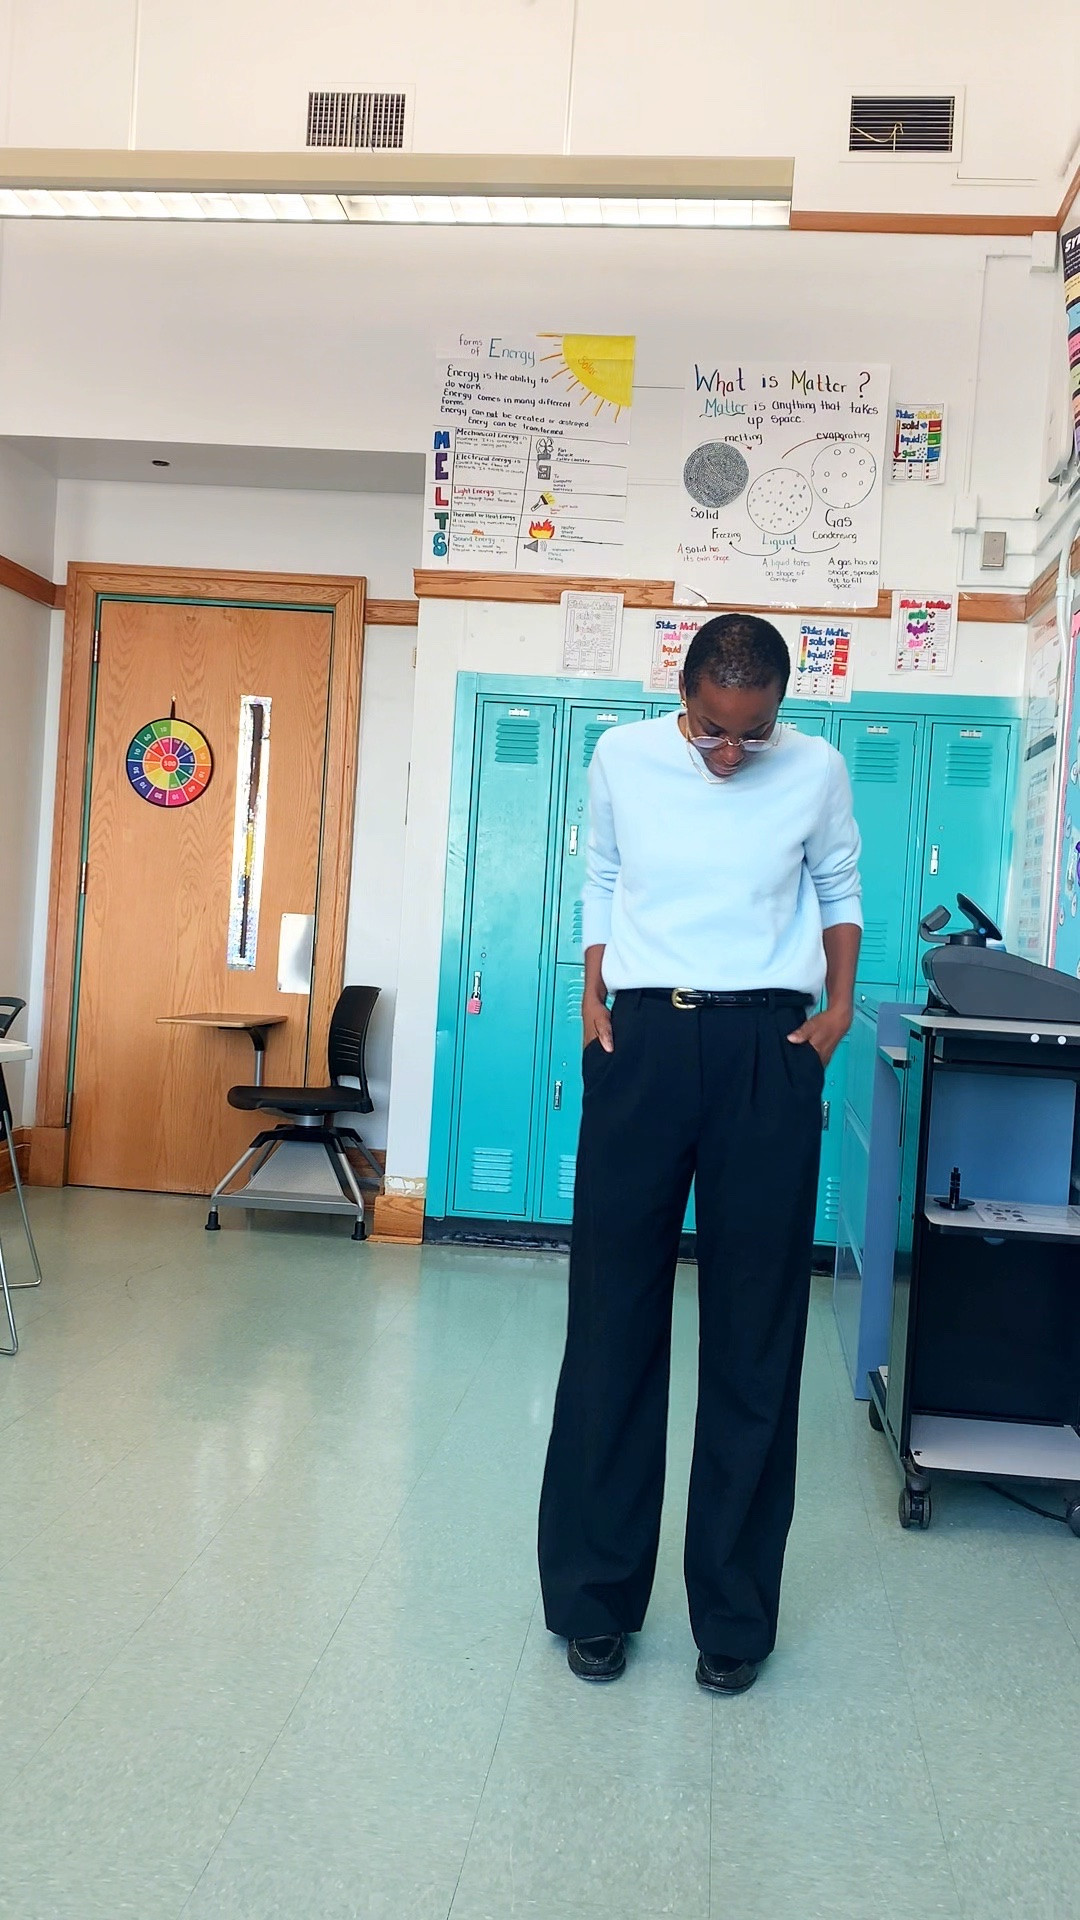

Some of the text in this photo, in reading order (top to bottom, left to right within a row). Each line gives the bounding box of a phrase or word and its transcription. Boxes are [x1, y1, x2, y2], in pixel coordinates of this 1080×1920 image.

[471, 347, 480, 356] of
[489, 338, 535, 368] Energy
[447, 364, 480, 382] Energy
[483, 372, 492, 380] is
[495, 372, 508, 380] the
[510, 372, 536, 388] ability
[695, 364, 746, 396] What
[762, 374, 779, 388] is
[791, 370, 848, 396] Matter
[445, 380, 455, 388] do
[444, 388, 472, 400] Energy
[478, 394, 500, 402] comes
[514, 398, 536, 407] many
[538, 398, 570, 408] different
[440, 406, 466, 416] Energy
[704, 398, 878, 415] Matter is anything that takes
[748, 416, 764, 429] up
[901, 420, 920, 430] solid
[456, 428, 496, 438] Mechanical
[498, 432, 519, 440] Energy
[724, 433, 764, 444] melting
[816, 431, 870, 442] evaporating
[900, 434, 920, 446] liquid
[456, 454, 490, 462] Electrical
[902, 450, 916, 458] gas
[454, 486, 470, 496] Light
[472, 488, 494, 496] Energy
[690, 506, 719, 520] Solid
[825, 508, 853, 528] Gas
[712, 528, 742, 544] Freezing
[812, 531, 857, 544] Condensing
[762, 534, 796, 550] Liquid
[677, 543, 684, 554] A
[686, 545, 708, 554] solid
[762, 558, 768, 567] A
[771, 558, 790, 568] liquid
[828, 557, 834, 566] A
[837, 558, 852, 570] gas
[854, 558, 868, 566] has
[776, 570, 794, 578] shape
[809, 636, 827, 646] solid
[662, 644, 681, 656] liquid
[807, 650, 826, 661] liquid
[664, 660, 678, 668] gas
[808, 666, 822, 674] gas
